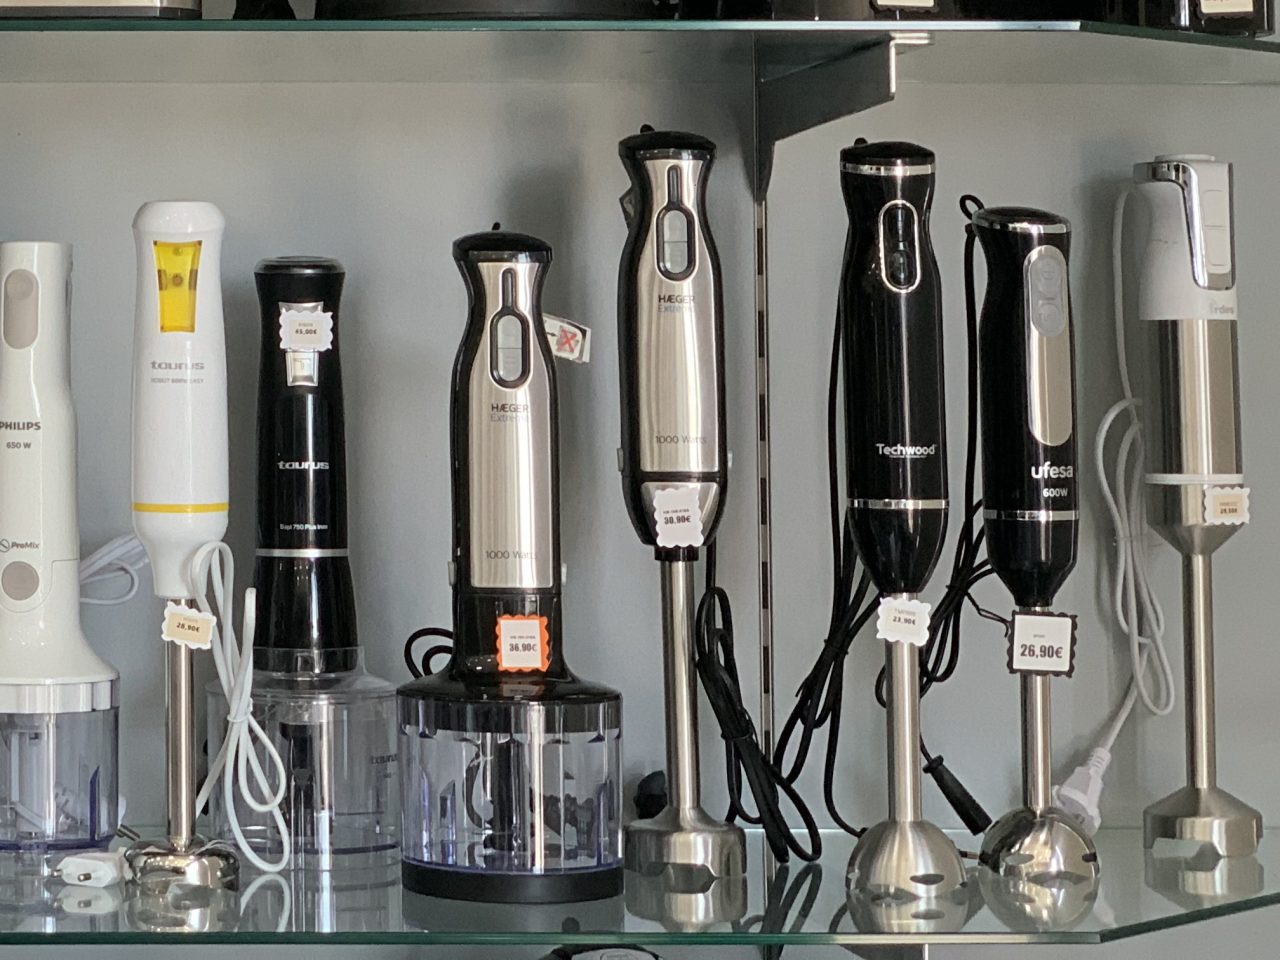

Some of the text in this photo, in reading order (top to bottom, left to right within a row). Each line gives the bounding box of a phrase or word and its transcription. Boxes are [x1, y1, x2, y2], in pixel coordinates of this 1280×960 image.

[150, 360, 205, 370] taurus
[655, 435, 679, 444] 1000
[6, 441, 32, 449] 650 W
[876, 443, 935, 455] Techwood
[278, 461, 330, 469] taurus
[1031, 461, 1074, 479] ufesa
[1043, 488, 1068, 498] 600W
[10, 541, 40, 549] ProMix
[485, 551, 510, 560] 1000
[1020, 643, 1063, 660] 26,90€
